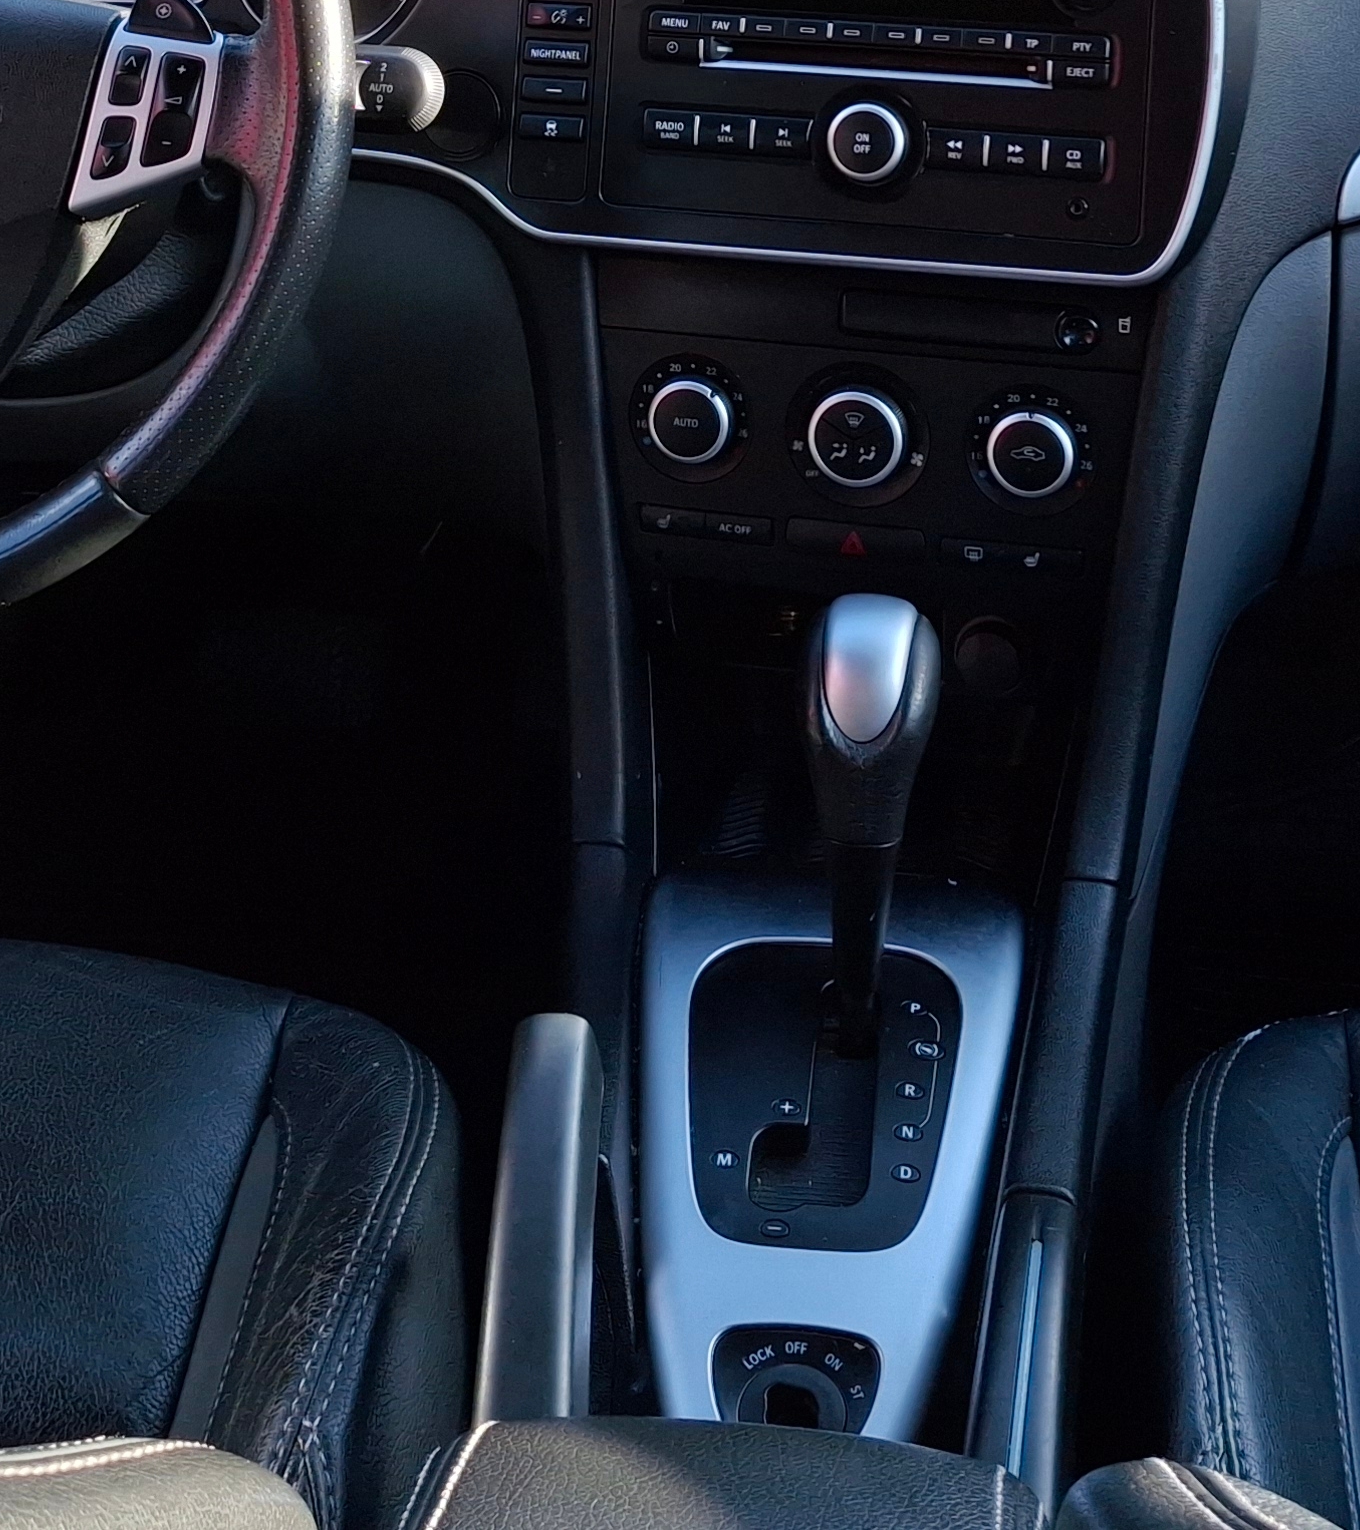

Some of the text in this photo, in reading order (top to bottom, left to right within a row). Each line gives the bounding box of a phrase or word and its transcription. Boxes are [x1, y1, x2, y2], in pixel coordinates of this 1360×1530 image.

[661, 17, 689, 28] MENU
[711, 20, 731, 31] FAV
[1025, 38, 1040, 49] TP
[1072, 41, 1093, 53] PTY
[530, 48, 581, 61] NIGHTPANEL
[380, 62, 388, 72] 2
[1066, 67, 1095, 78] EJECT
[368, 83, 394, 93] AUTO
[655, 120, 684, 132] RADIO
[717, 135, 734, 143] SEEK
[855, 132, 870, 142] ON
[775, 139, 792, 148] SEEK
[853, 143, 871, 154] OFF
[1066, 150, 1081, 160] CD
[669, 363, 682, 373] 20
[706, 366, 717, 376] 22
[1007, 394, 1021, 403] 20
[1046, 397, 1059, 407] 22
[673, 416, 699, 428] AUTO
[1080, 460, 1093, 471] 26
[718, 523, 752, 535] AC OFF
[910, 1003, 921, 1014] P
[905, 1084, 916, 1097] R
[902, 1126, 914, 1139] N
[716, 1153, 732, 1167] M
[900, 1166, 912, 1179] D
[785, 1341, 808, 1355] OFF
[742, 1345, 775, 1370] LOCK
[824, 1353, 844, 1372] ON
[850, 1384, 865, 1400] ST
